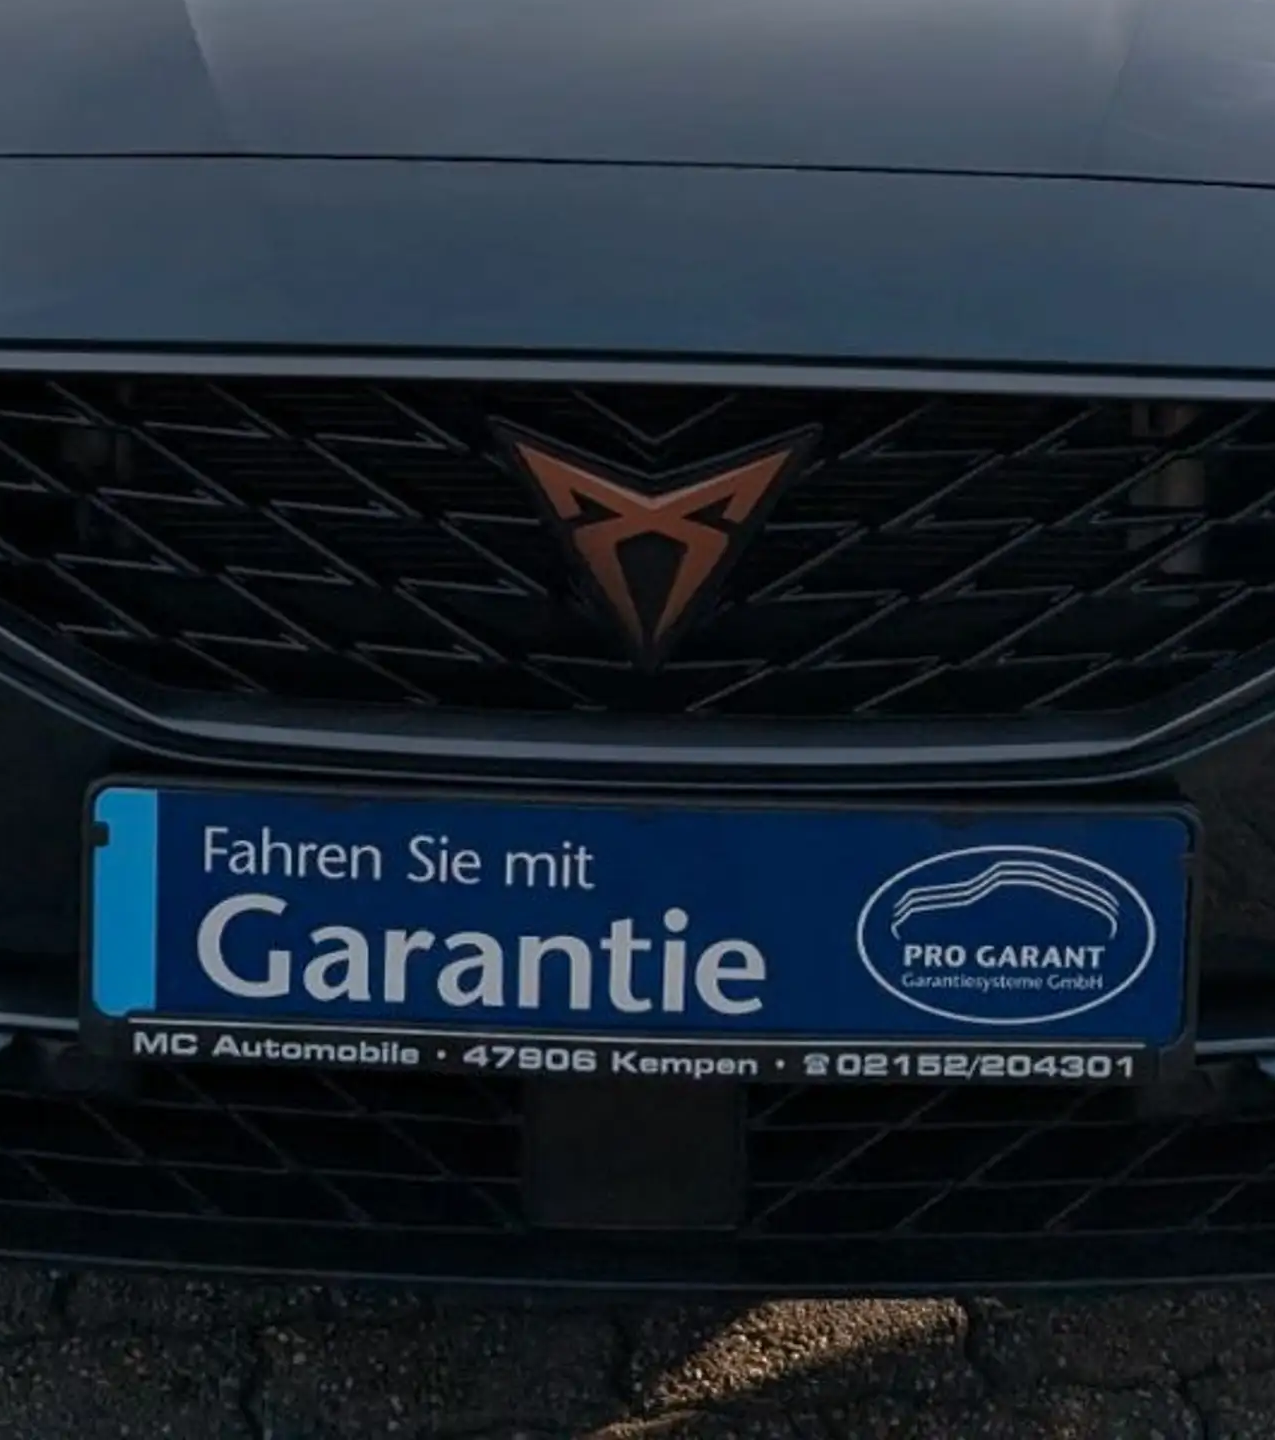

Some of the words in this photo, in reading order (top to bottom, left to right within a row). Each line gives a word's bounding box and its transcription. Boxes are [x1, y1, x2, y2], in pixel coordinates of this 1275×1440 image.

[203, 825, 383, 881] Fahren
[406, 834, 483, 886] Sie
[504, 840, 596, 890] mit
[196, 892, 767, 1015] Garantie
[903, 944, 966, 967] PRO
[975, 944, 1106, 968] GARANT
[901, 972, 1043, 994] Garantiesysteme
[1046, 973, 1105, 991] GmbH
[133, 1031, 199, 1056] MC
[212, 1033, 420, 1065] Automobile
[462, 1045, 598, 1072] 47906
[611, 1049, 759, 1080] Kempen
[836, 1053, 1134, 1079] 02152/204301
